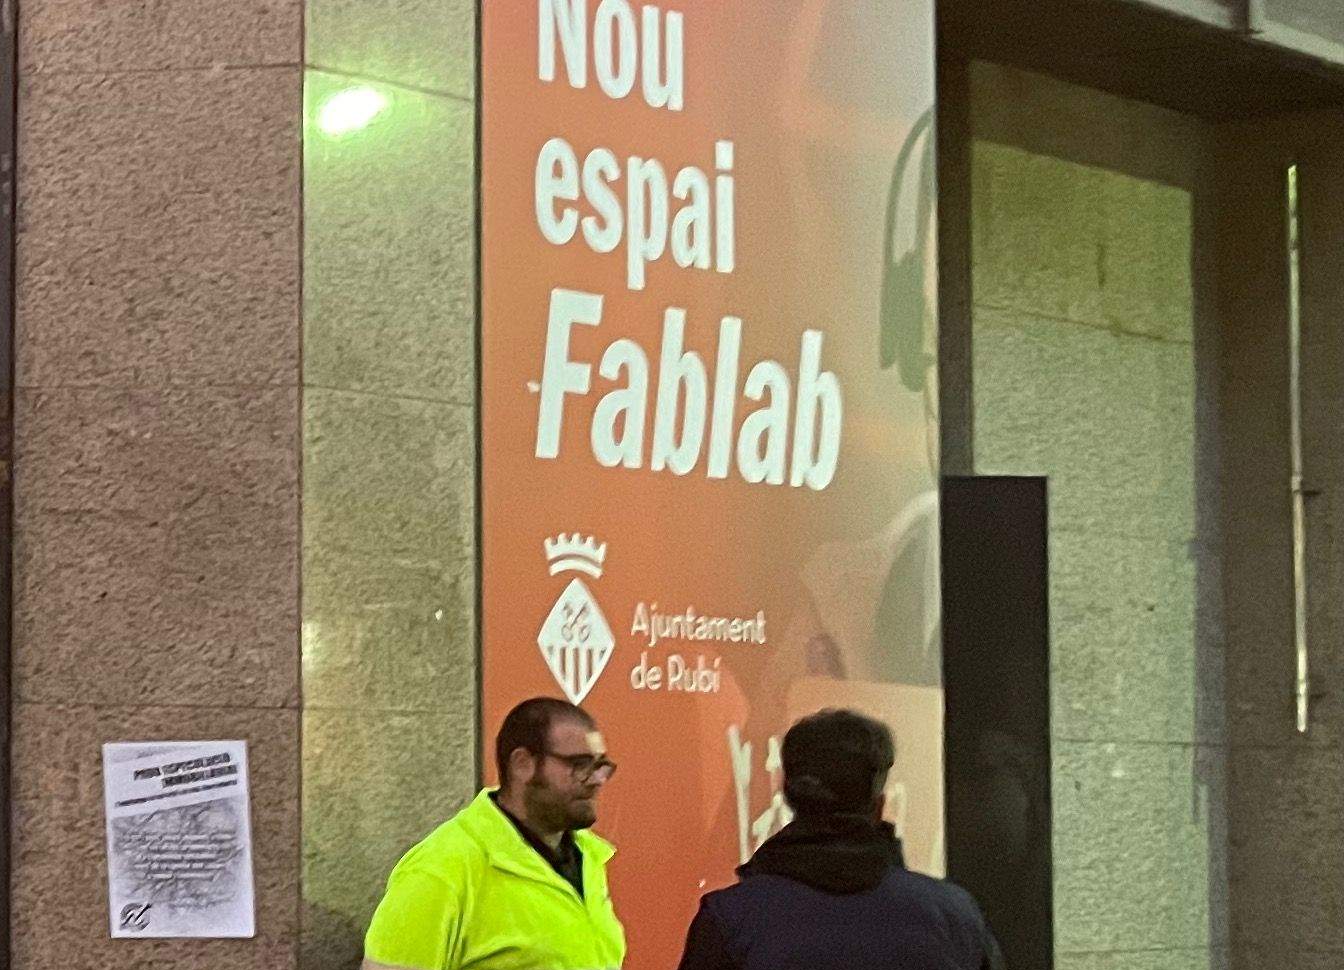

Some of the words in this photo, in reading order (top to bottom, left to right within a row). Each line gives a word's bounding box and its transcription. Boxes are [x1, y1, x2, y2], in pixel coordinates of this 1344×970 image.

[538, 0, 685, 111] Nou
[534, 137, 735, 291] espai
[534, 288, 844, 491] Fablab
[630, 602, 767, 647] Ajuntament
[630, 652, 663, 690] de
[667, 654, 722, 693] Rubí
